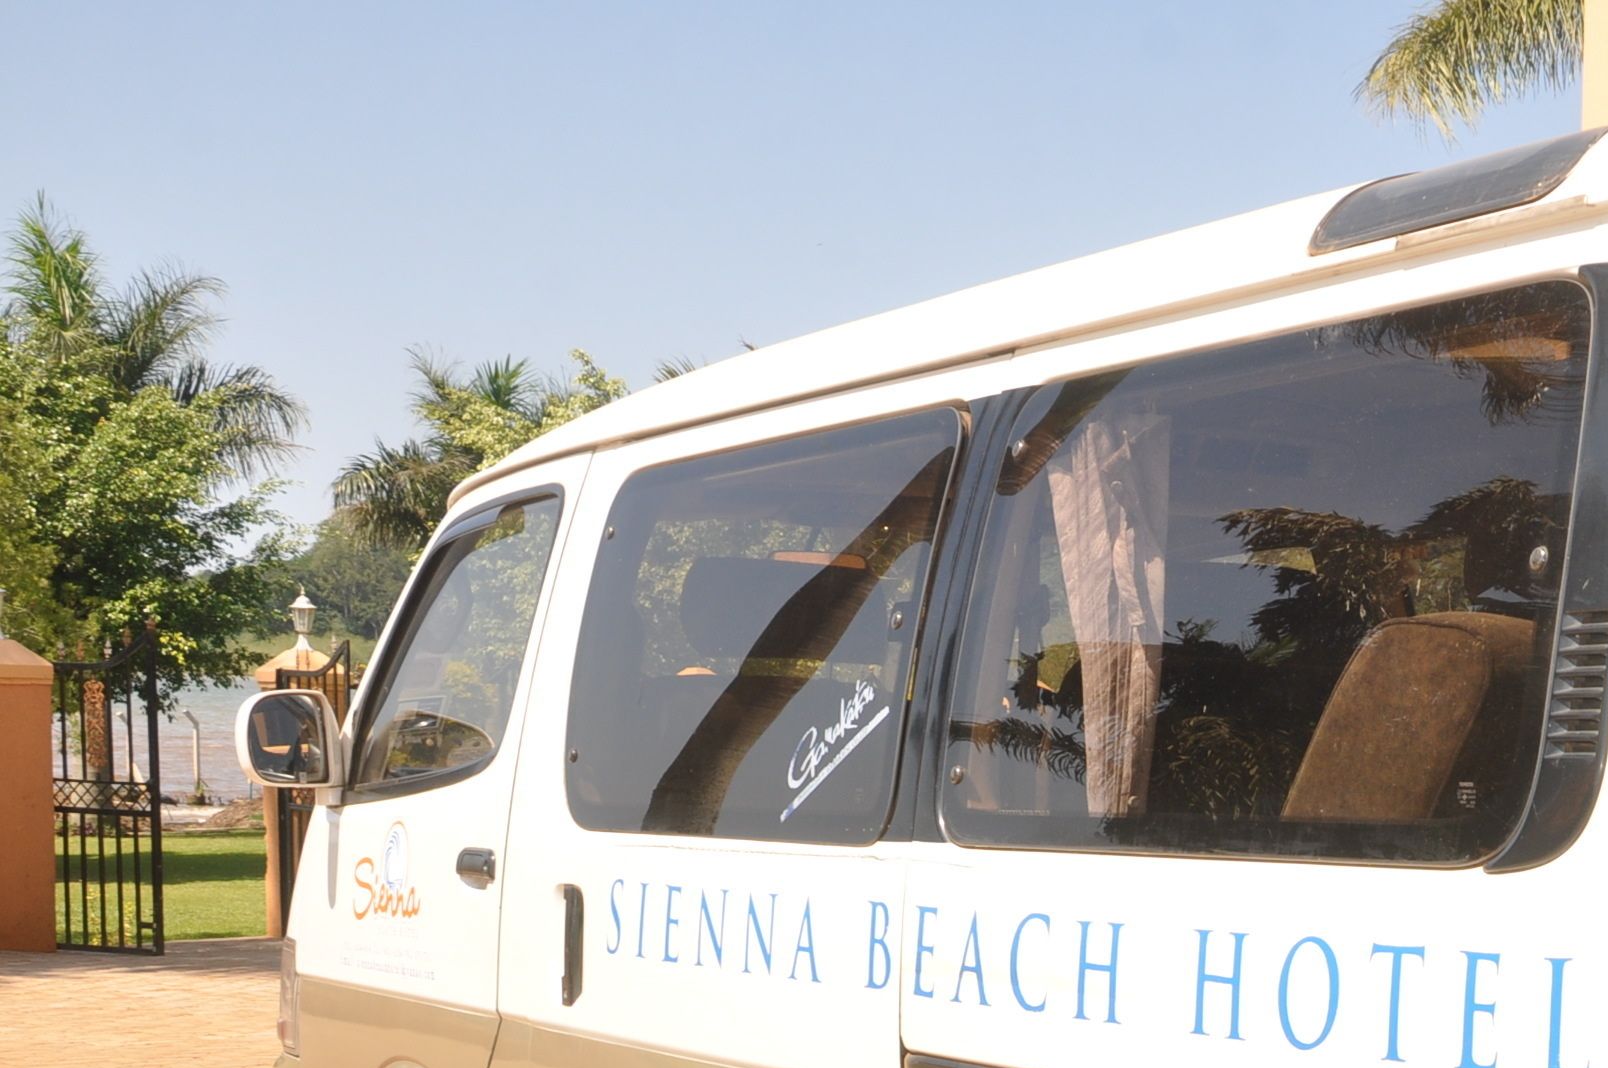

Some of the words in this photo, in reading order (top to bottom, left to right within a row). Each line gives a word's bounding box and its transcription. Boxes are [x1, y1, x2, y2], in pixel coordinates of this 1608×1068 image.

[352, 856, 421, 921] Sienna
[605, 878, 822, 984] SIENNA
[865, 899, 1126, 1026] BEACH
